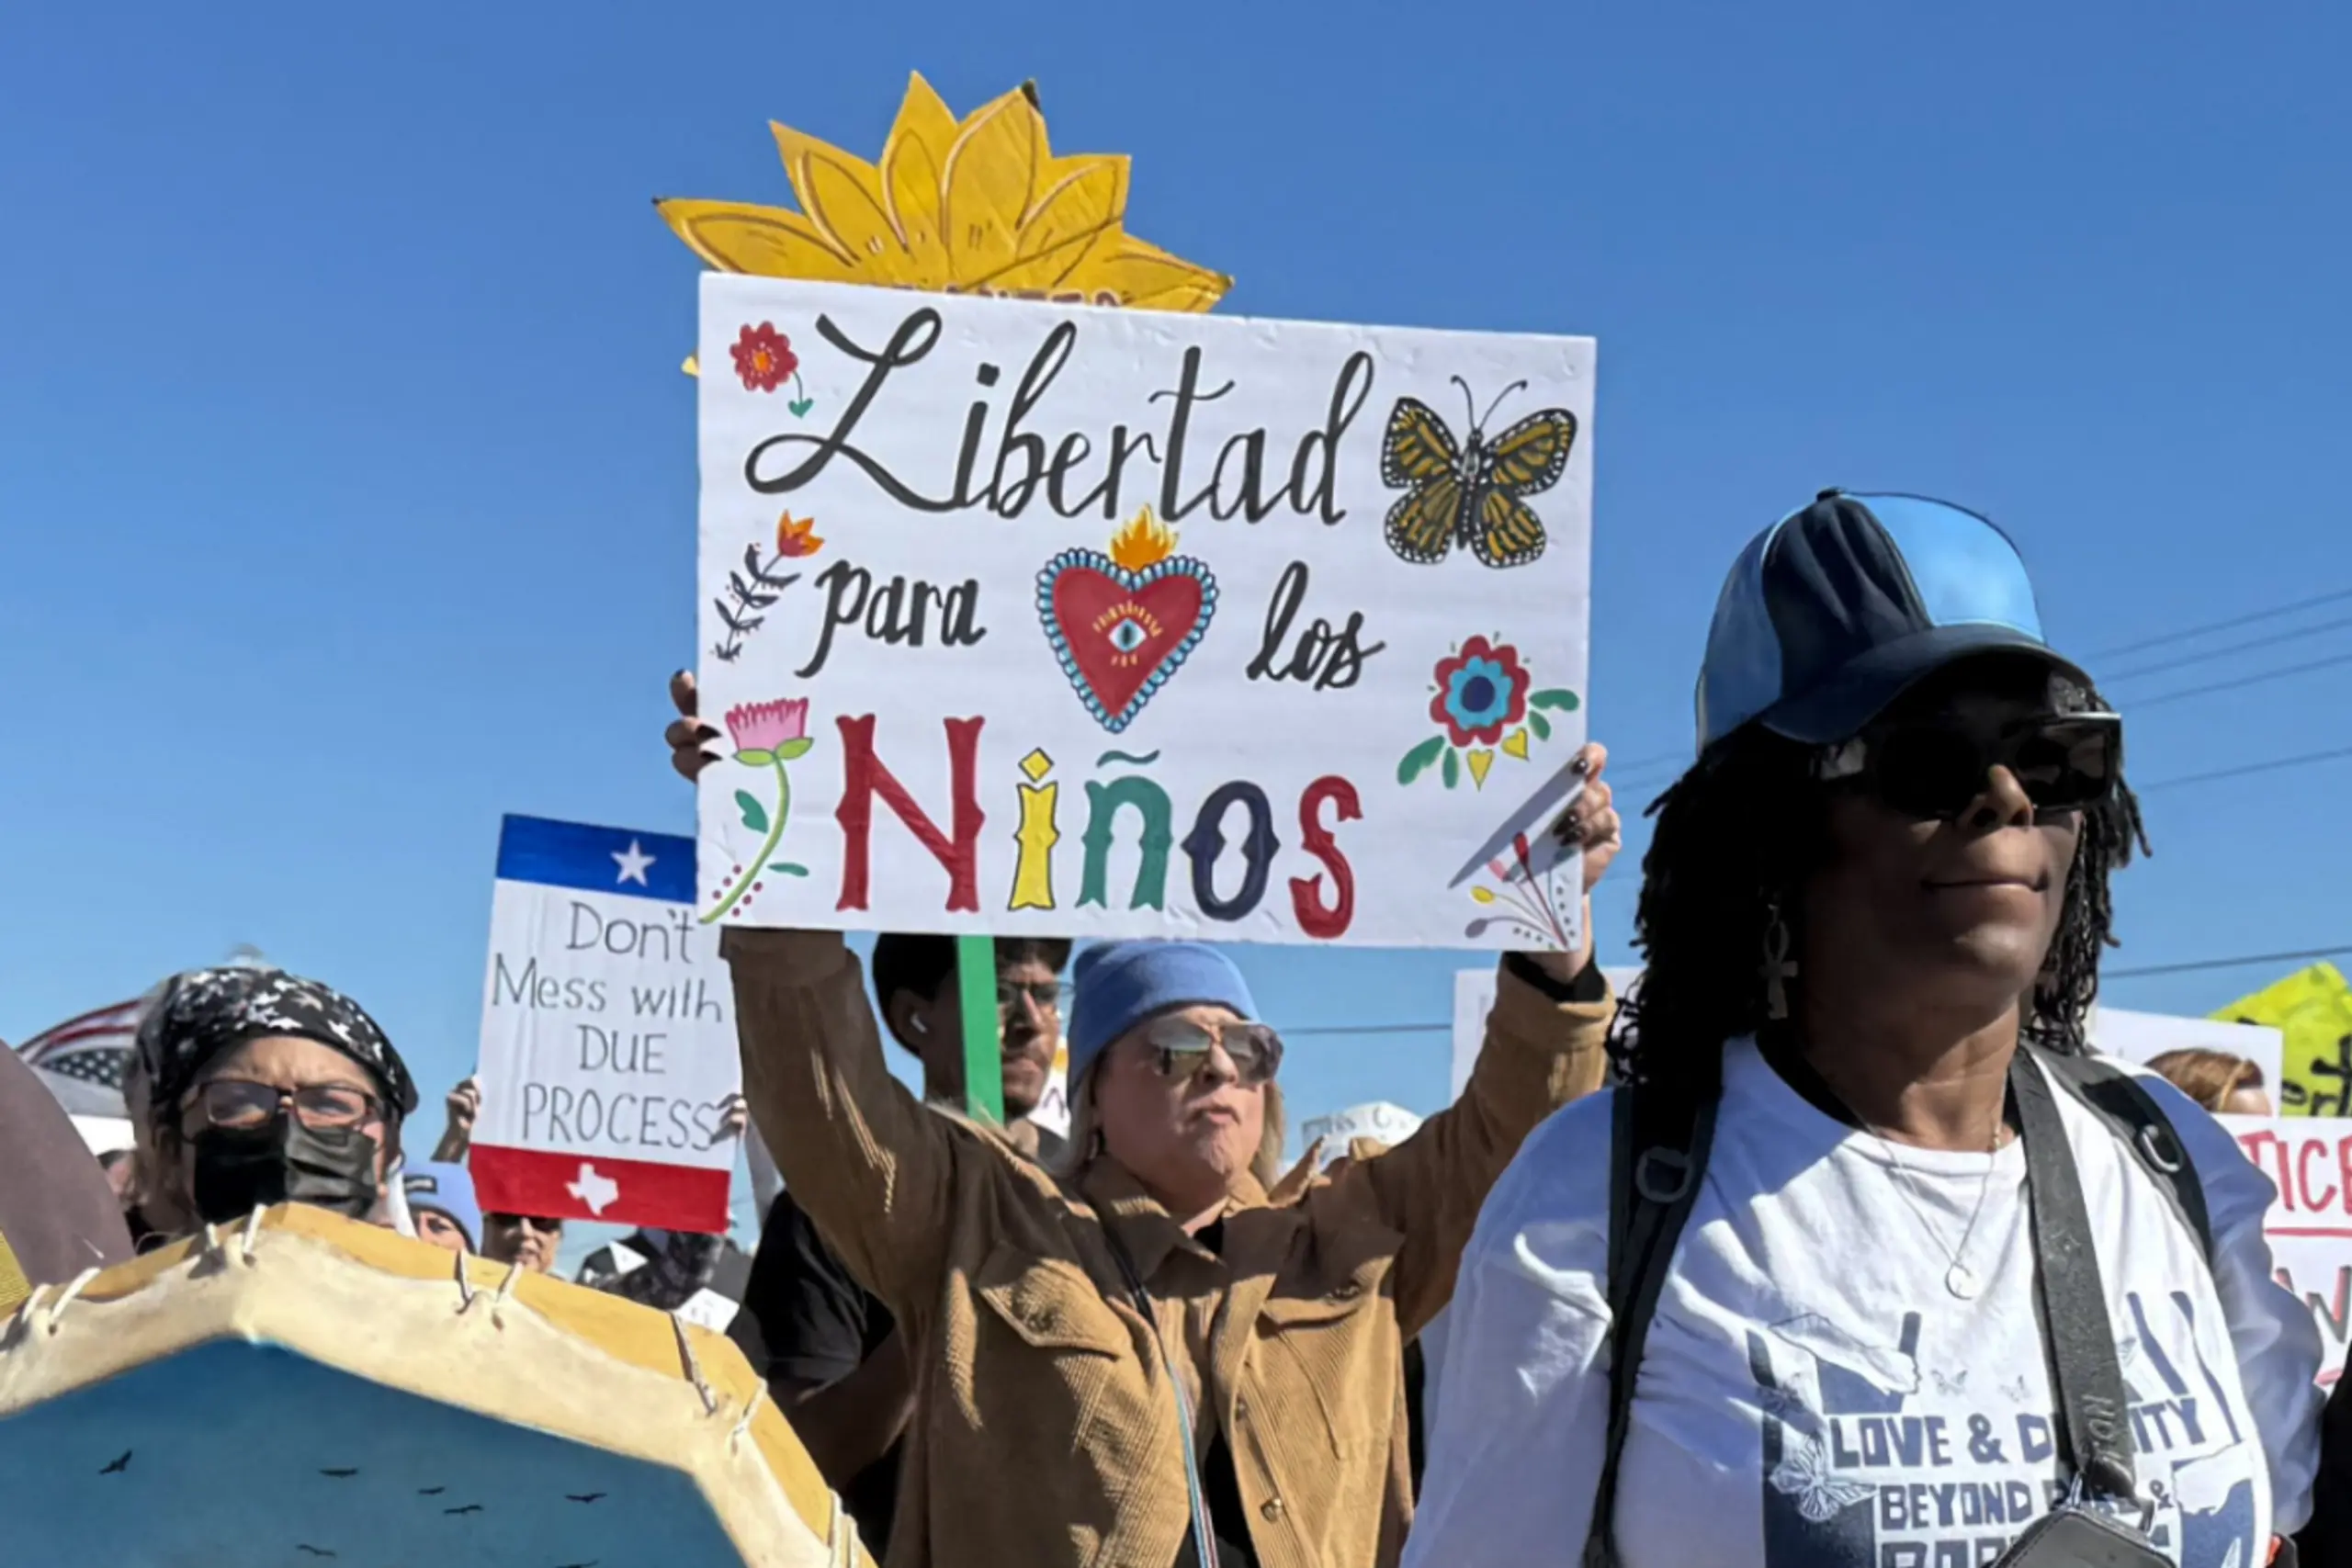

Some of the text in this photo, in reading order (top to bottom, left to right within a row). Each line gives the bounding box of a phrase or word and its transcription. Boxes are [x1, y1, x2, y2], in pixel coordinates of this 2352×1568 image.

[744, 307, 1374, 524] Libertad
[795, 559, 1385, 691] para los
[834, 713, 1363, 940] Niños
[565, 900, 695, 964] Don't
[492, 952, 606, 1012] Mess
[575, 1024, 667, 1074] DUE
[522, 1082, 718, 1153] PROCESS
[1830, 1416, 1952, 1468] LOVE
[1967, 1413, 2009, 1464] &
[2016, 1397, 2206, 1464] DITY
[1879, 1480, 2033, 1530] BEYOND
